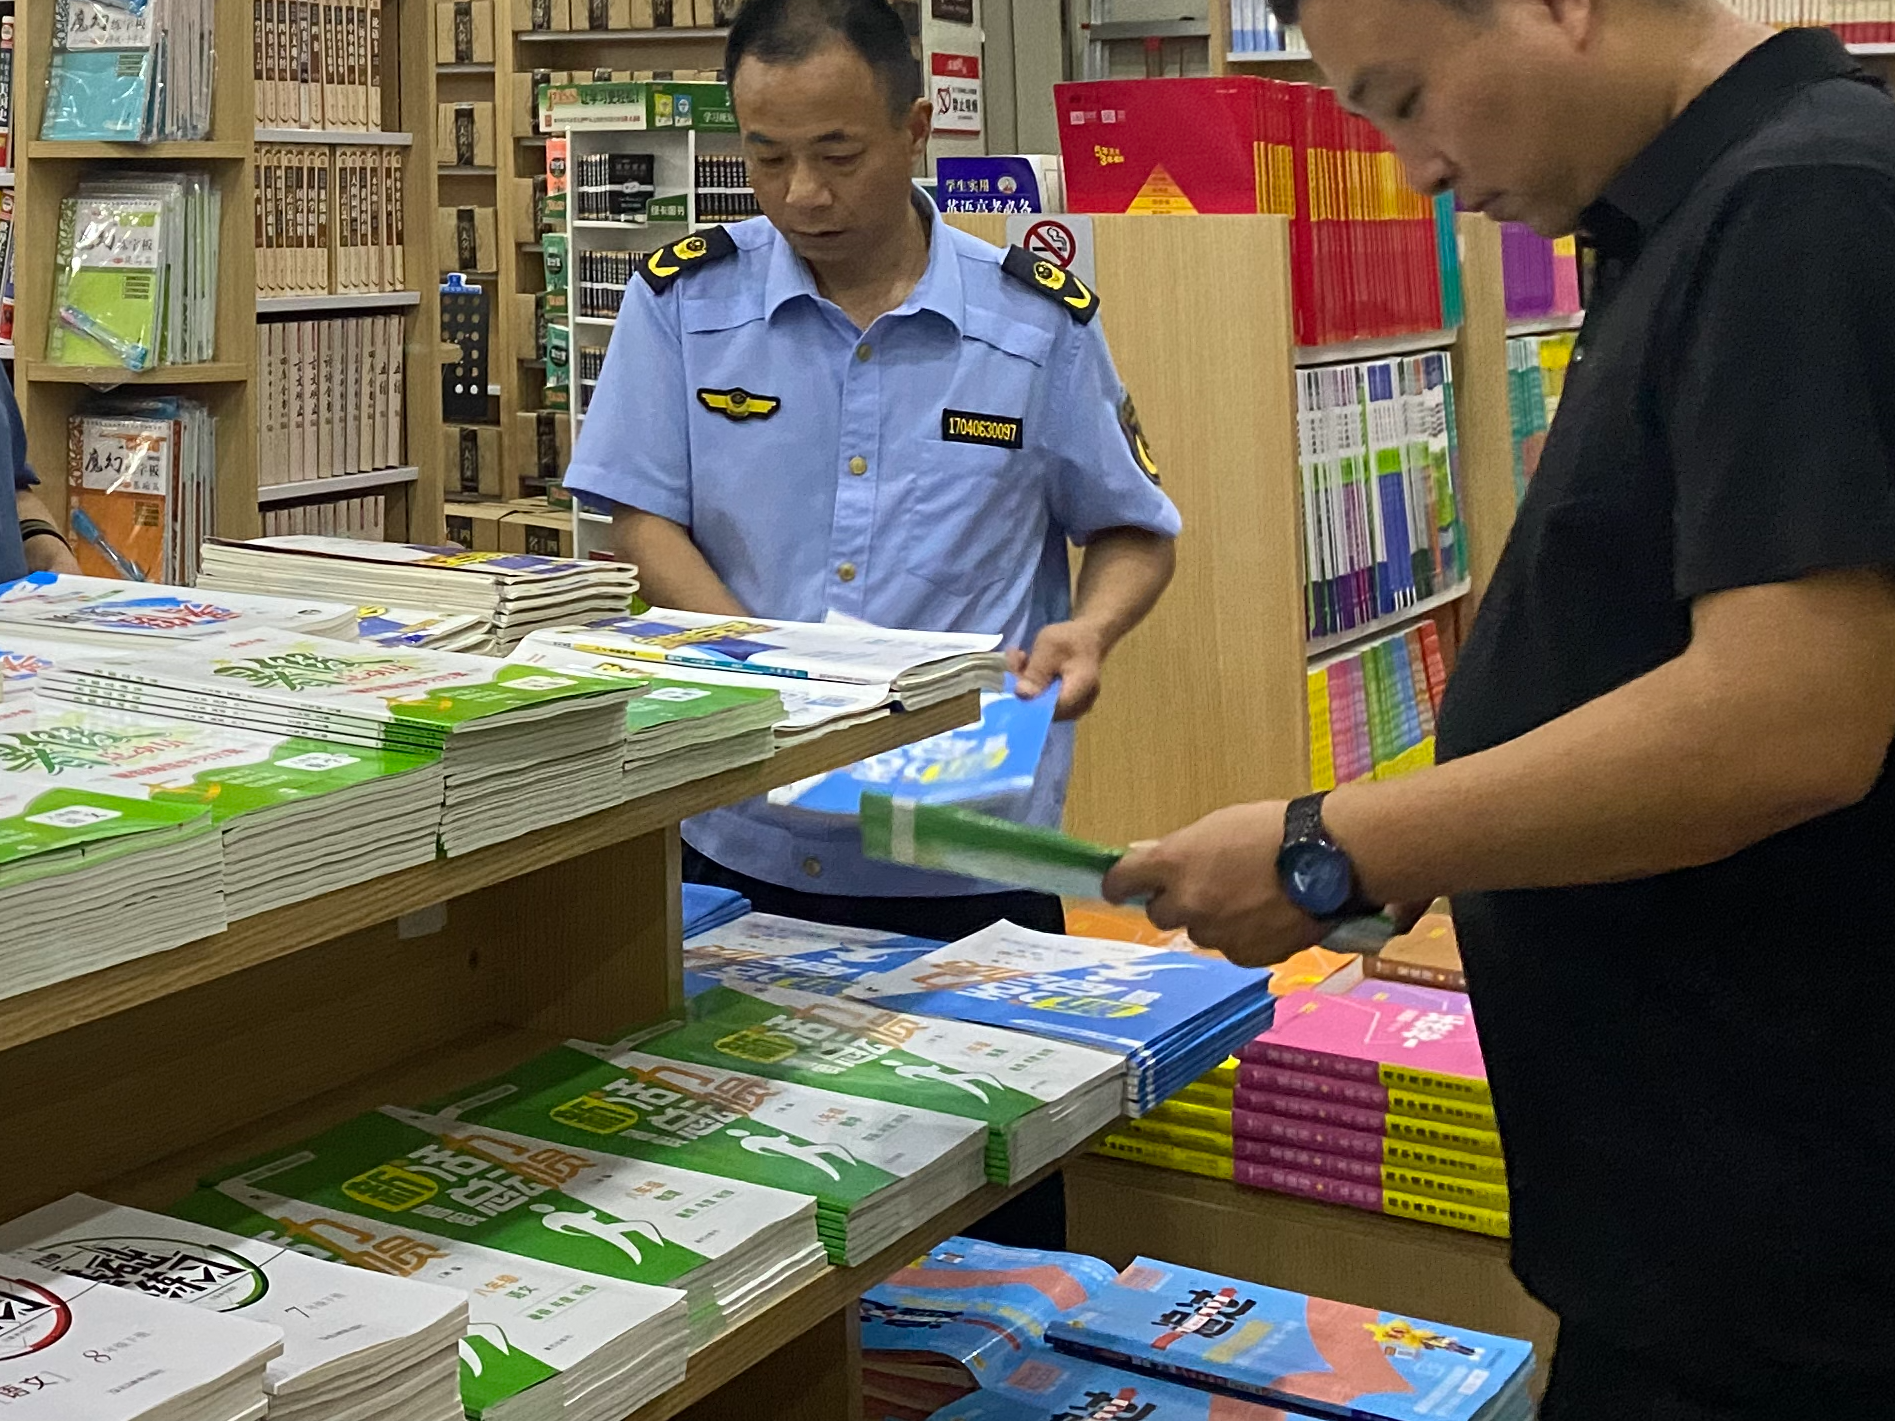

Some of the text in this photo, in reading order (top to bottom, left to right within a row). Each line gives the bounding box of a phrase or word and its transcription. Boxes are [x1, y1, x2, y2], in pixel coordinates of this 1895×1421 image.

[953, 97, 978, 113] 禁止吸烟
[945, 179, 989, 193] 学生实用
[949, 417, 1017, 441] 17040630097
[213, 652, 401, 692] 暑假
[336, 663, 414, 685] 总动员
[97, 739, 193, 765] 总动员
[551, 1066, 714, 1134] 新活力
[646, 1079, 781, 1147] 总动员
[342, 1134, 528, 1212] 新活力
[443, 1147, 596, 1226] 总动员
[474, 1274, 519, 1296] 八年级
[505, 1285, 539, 1299] 语文
[83, 1329, 154, 1365] 8年级下册
